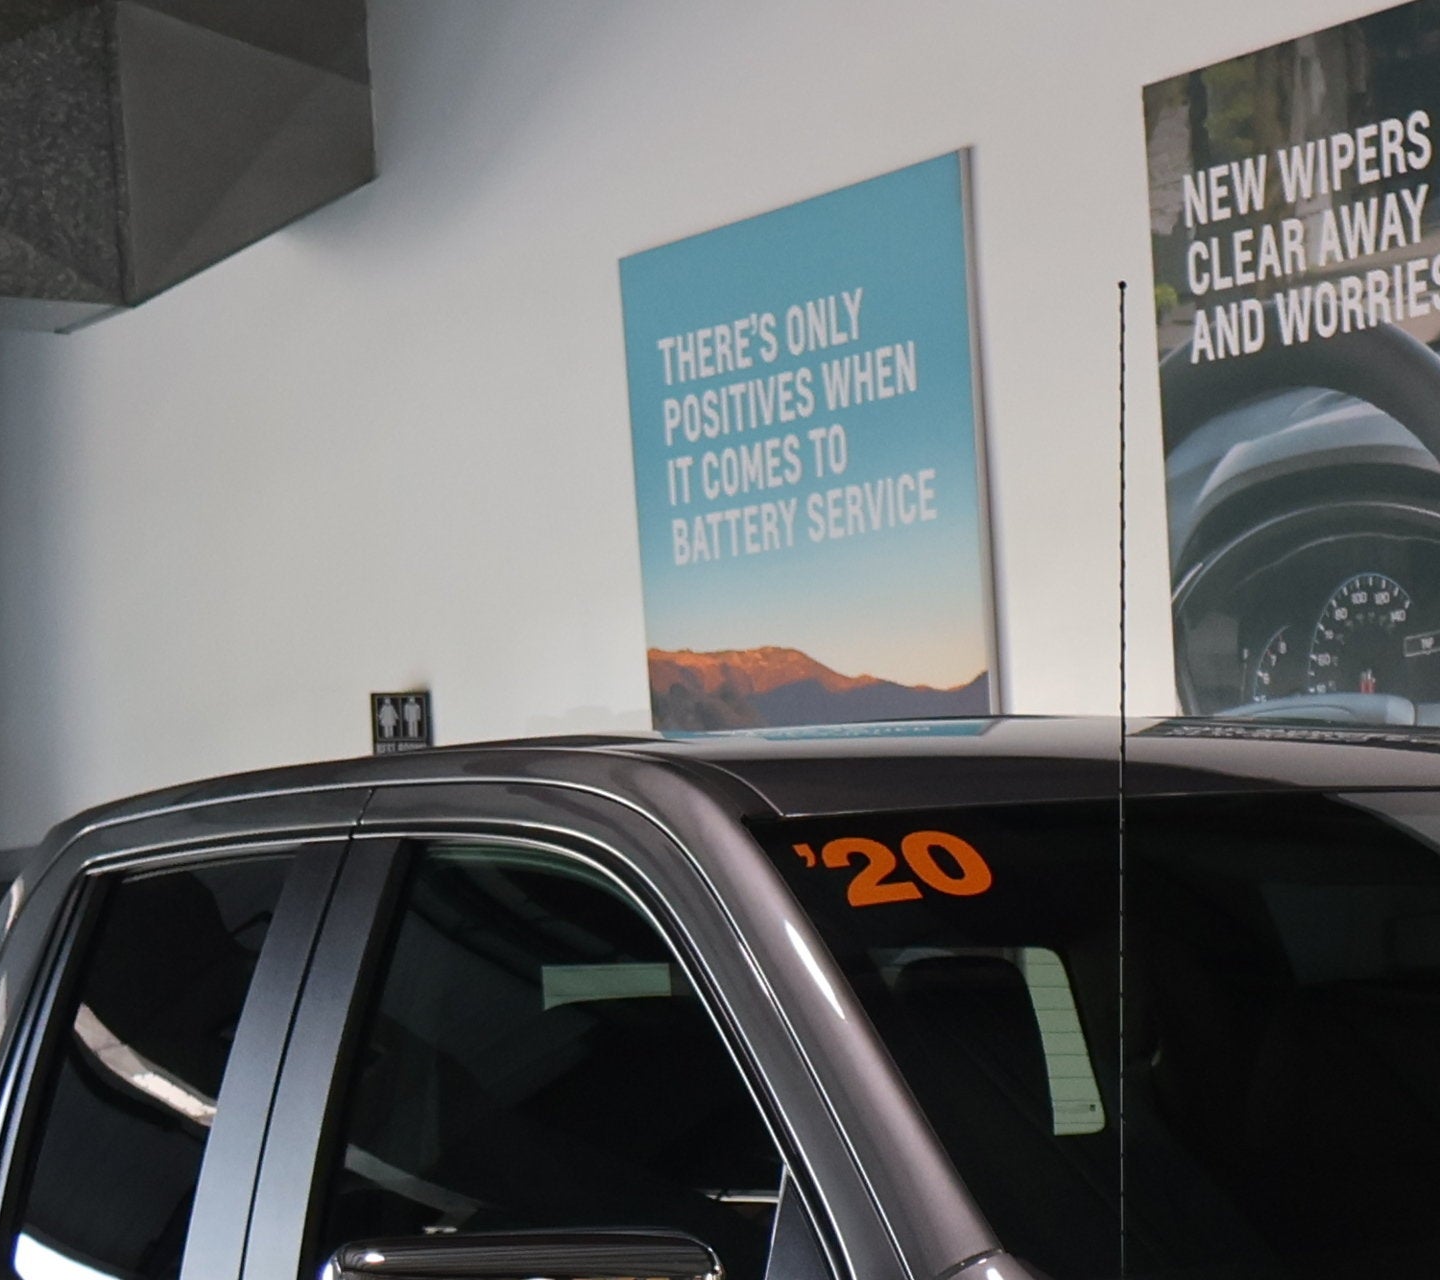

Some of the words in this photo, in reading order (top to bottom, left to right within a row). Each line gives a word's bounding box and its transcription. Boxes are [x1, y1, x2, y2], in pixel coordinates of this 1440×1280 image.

[1182, 154, 1267, 229] NEW
[1277, 109, 1433, 203] WIPERS
[1187, 223, 1307, 295] CLEAR
[1317, 184, 1430, 267] AWAY
[657, 310, 777, 386] THERE'S
[786, 287, 864, 357] ONLY
[1190, 298, 1266, 365] AND
[663, 366, 815, 447] POSITIVES
[820, 340, 918, 412] WHEN
[666, 456, 693, 506] IT
[702, 434, 802, 501] COMES
[808, 424, 849, 475] TO
[670, 498, 798, 566] BATTERY
[807, 468, 939, 542] SERVICE
[792, 830, 994, 907] '20
